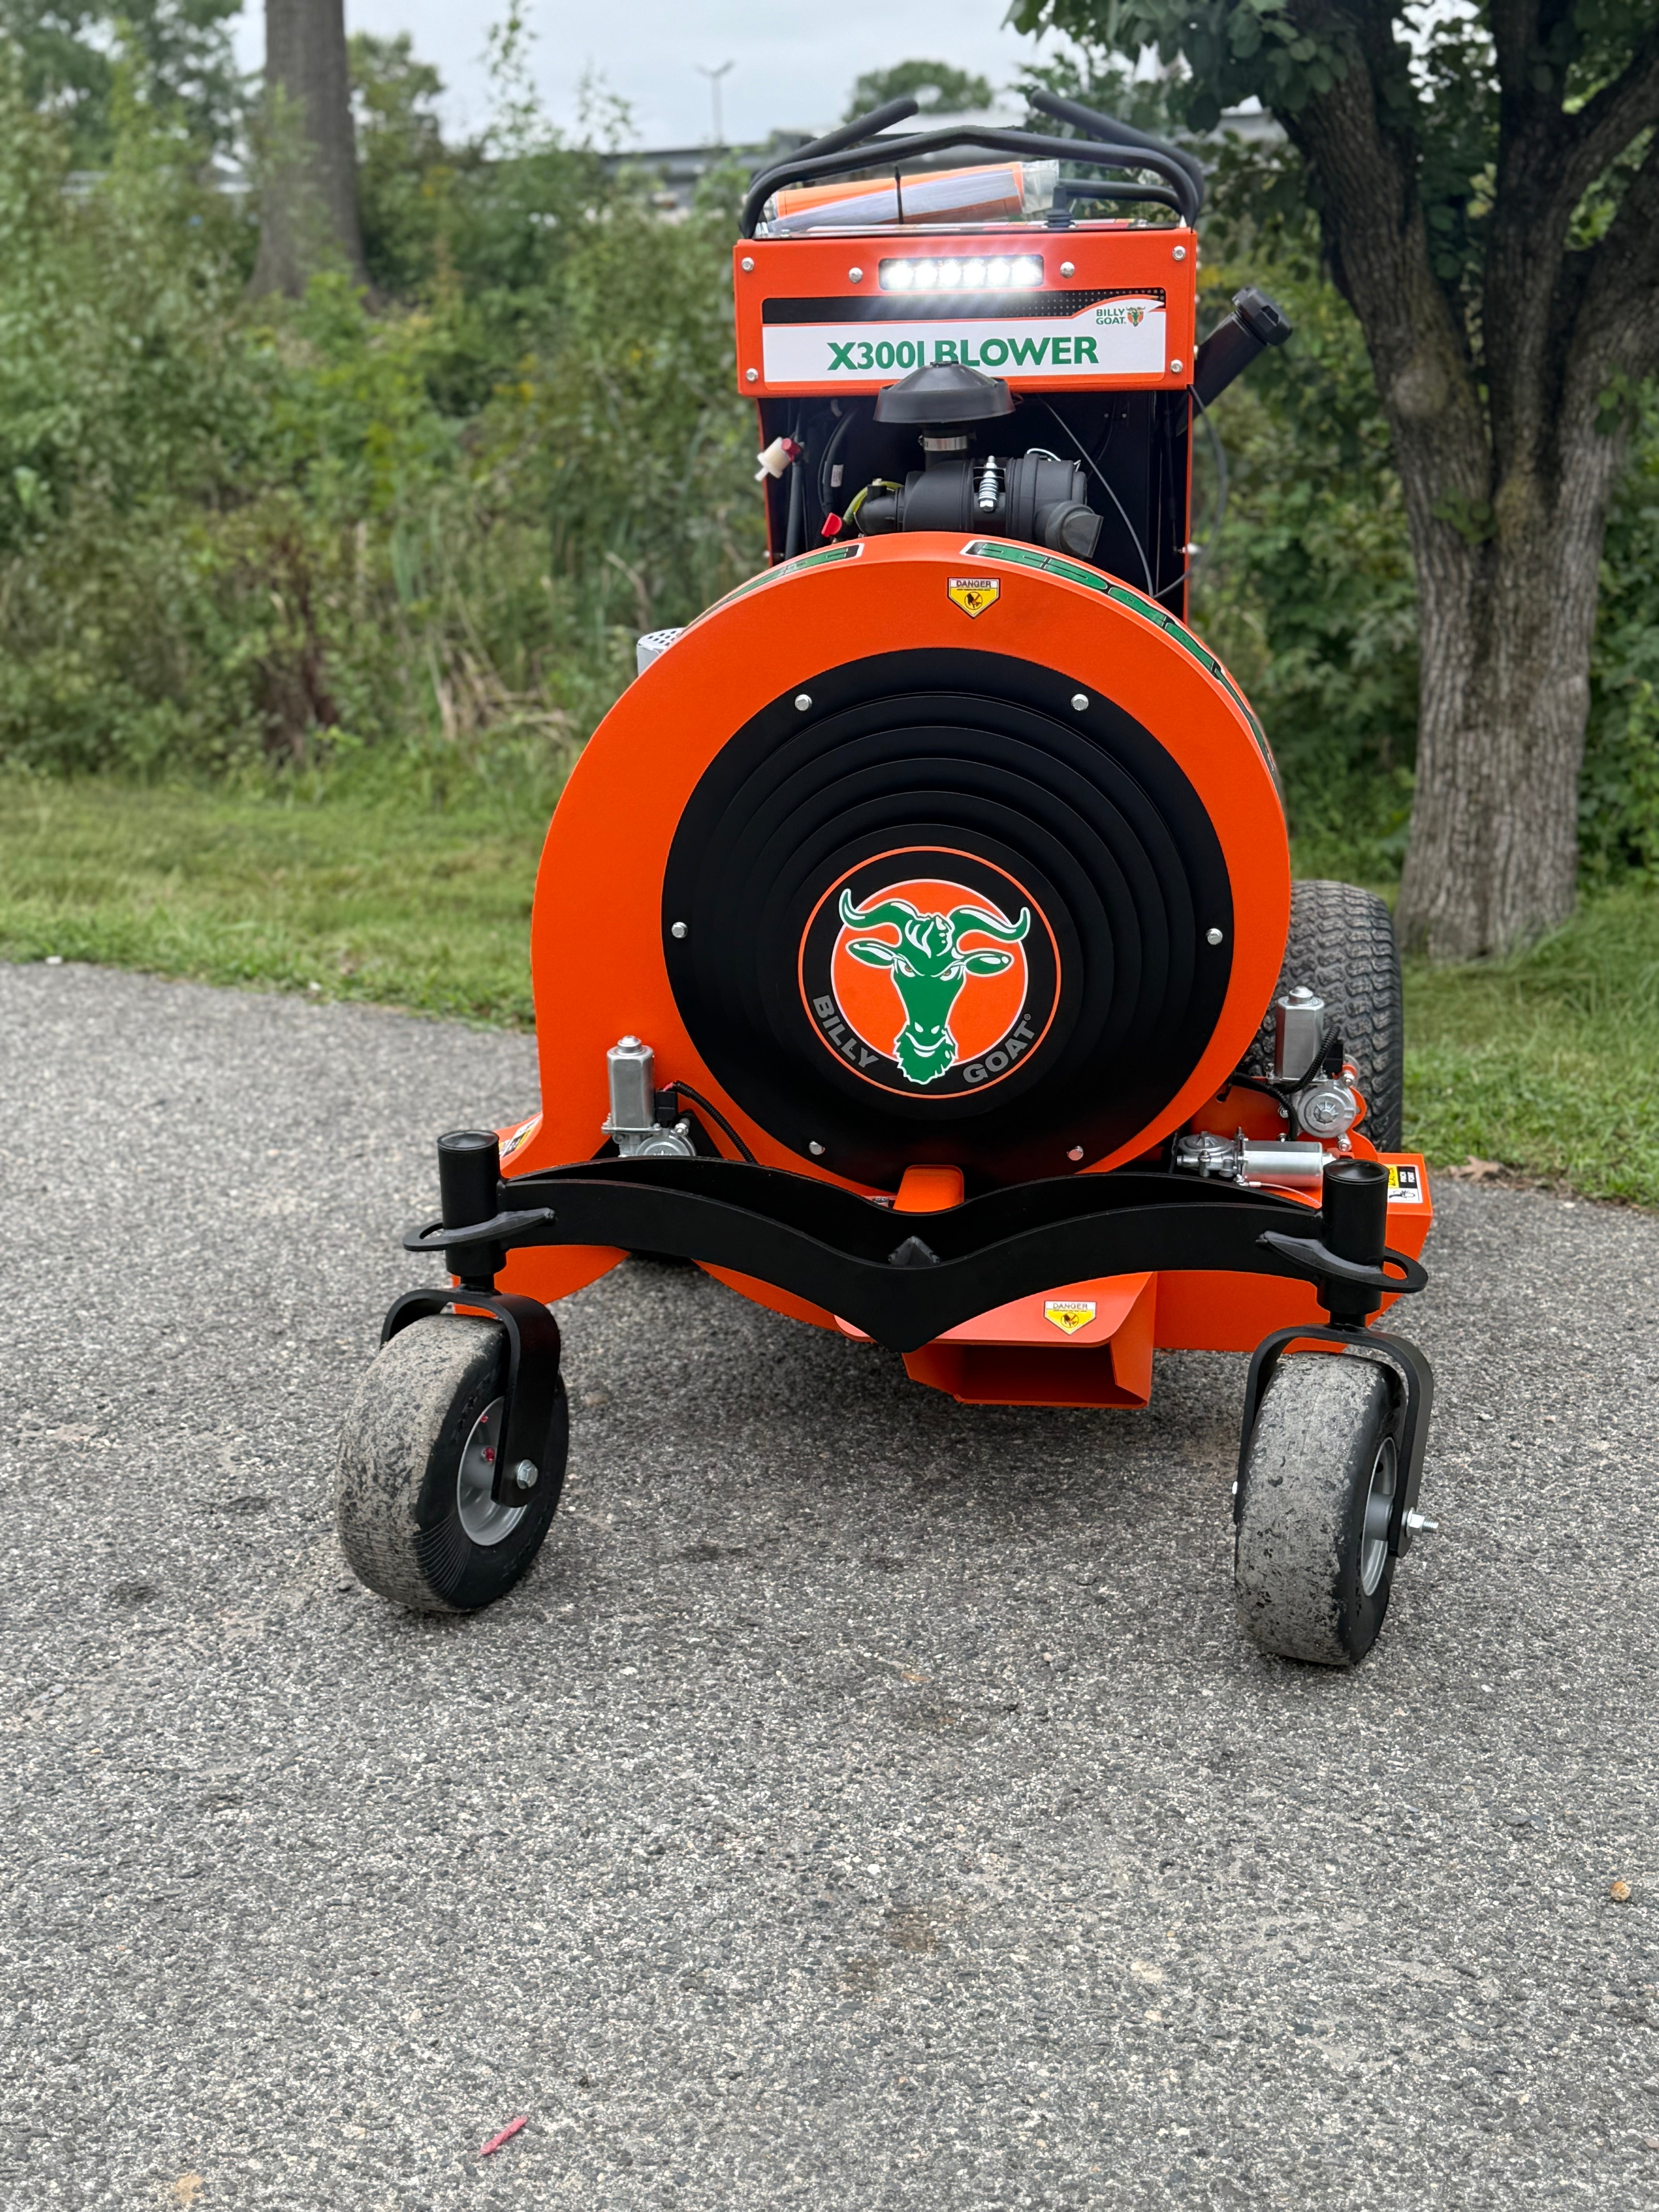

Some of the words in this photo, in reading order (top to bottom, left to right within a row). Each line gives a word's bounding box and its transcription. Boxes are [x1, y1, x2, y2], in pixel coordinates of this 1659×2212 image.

[1096, 308, 1125, 316] BILLY
[934, 336, 1099, 367] BLOWER
[956, 580, 992, 588] DANGER
[813, 994, 879, 1068] BILLY
